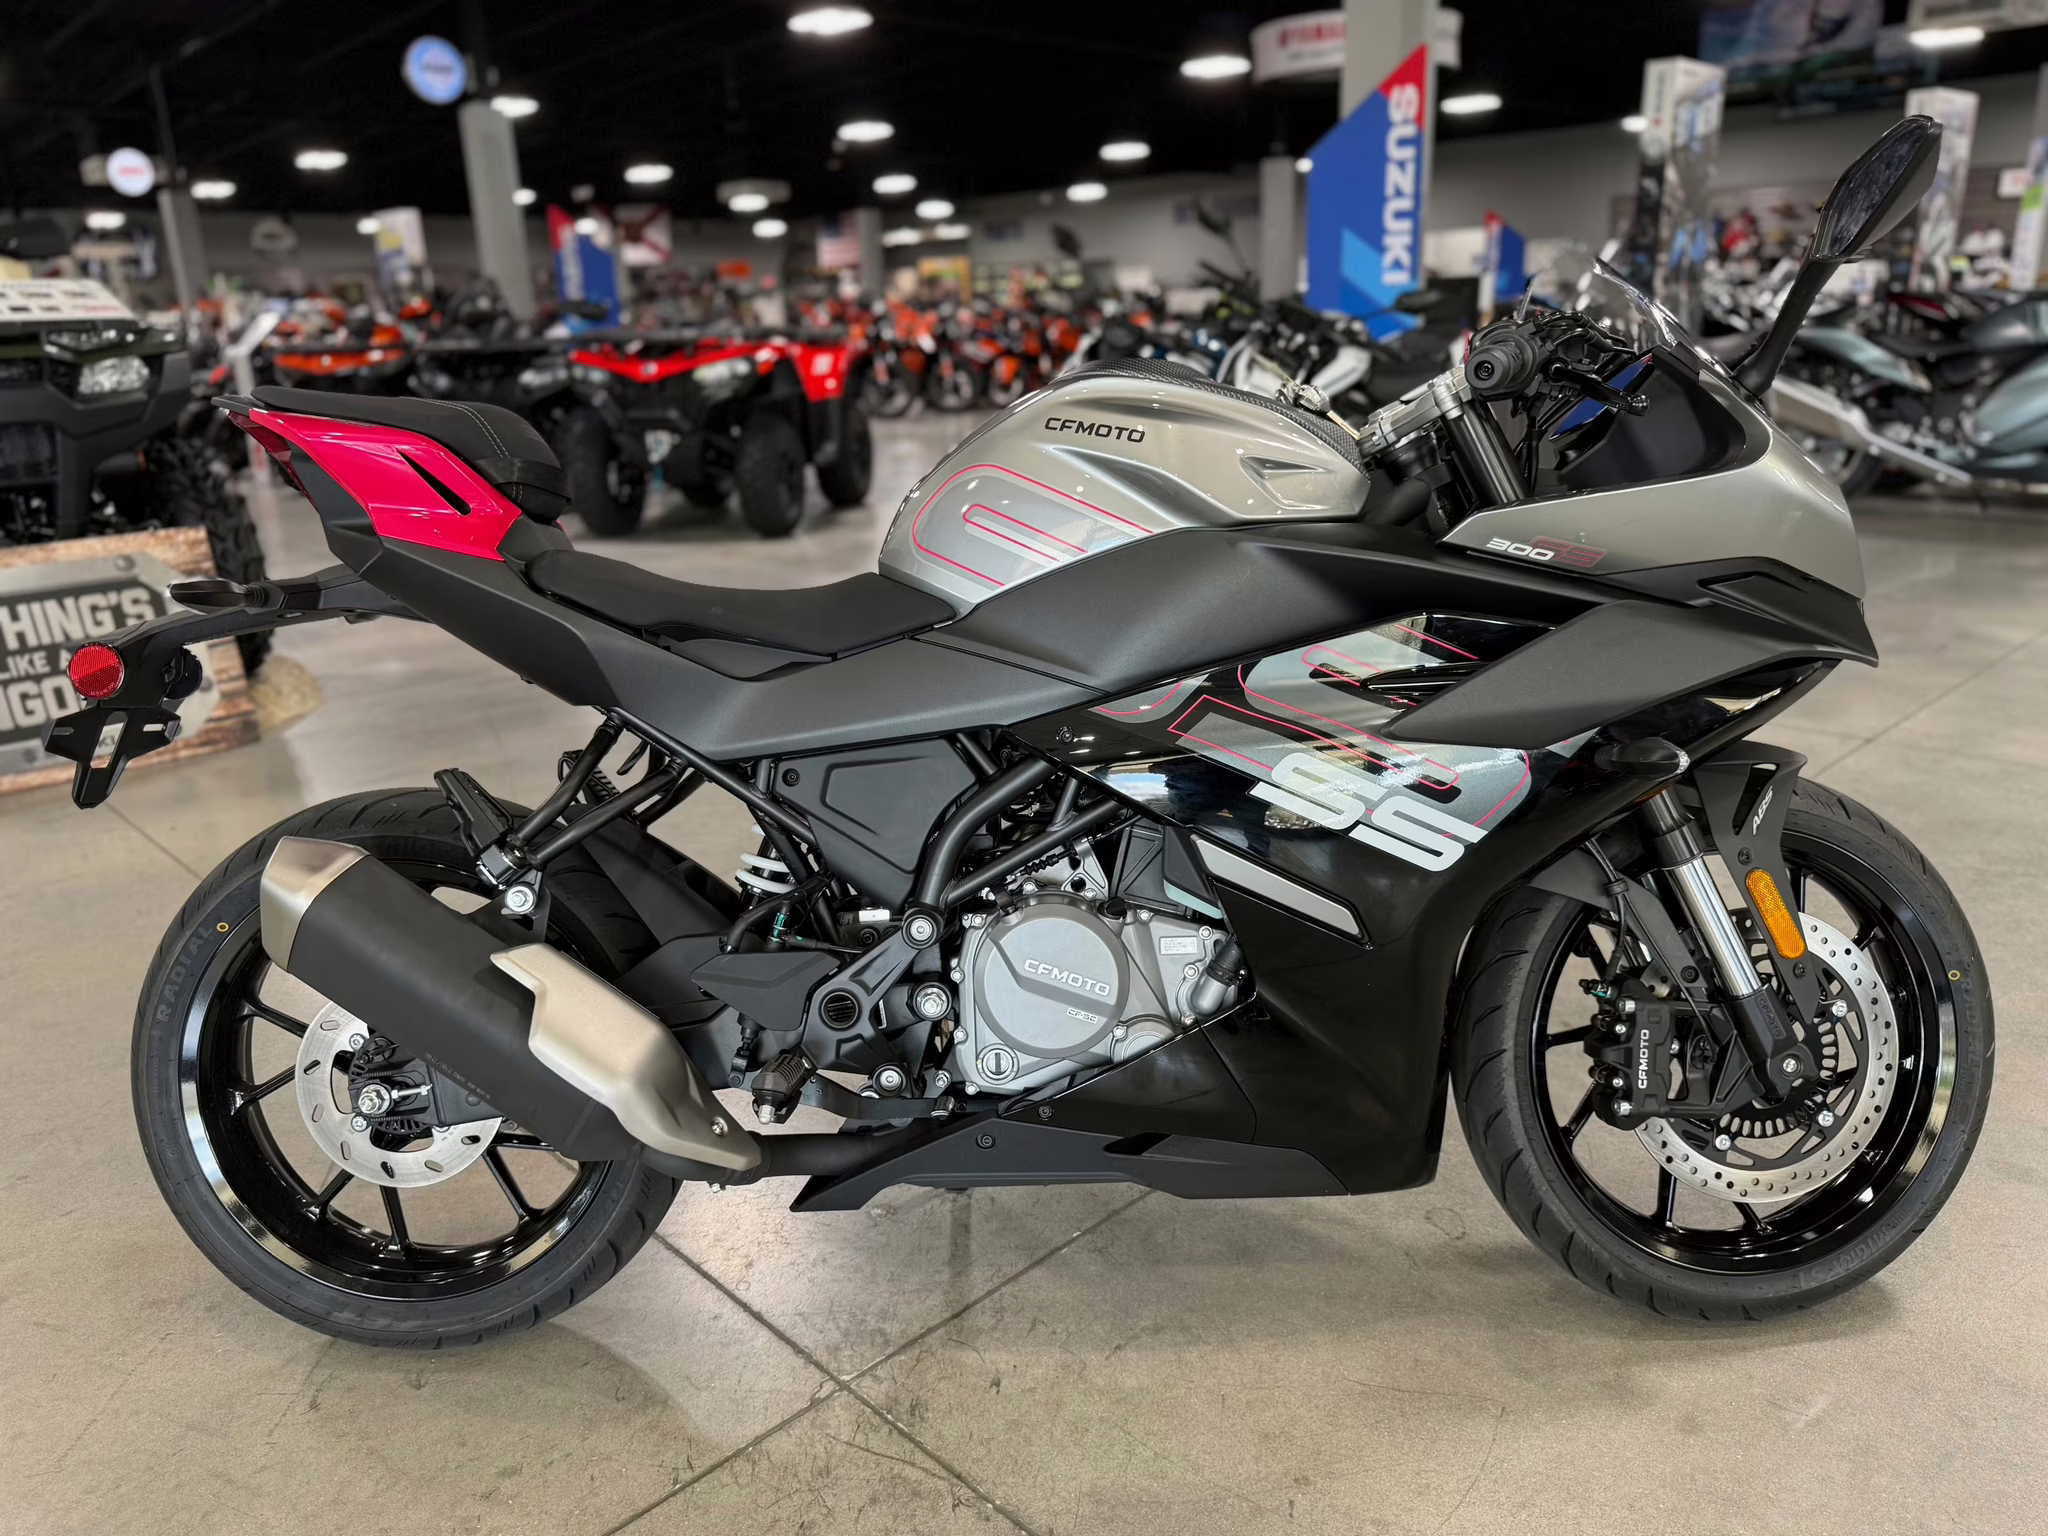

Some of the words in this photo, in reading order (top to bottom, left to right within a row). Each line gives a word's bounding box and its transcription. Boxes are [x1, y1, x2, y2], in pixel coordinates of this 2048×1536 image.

[1381, 82, 1420, 286] SUZUKI
[1045, 417, 1146, 443] CFMOTO
[1752, 785, 1773, 836] ABS
[156, 926, 214, 1023] RADIAL
[1024, 959, 1110, 997] CFMOTO
[1638, 1029, 1650, 1090] CFMOTO
